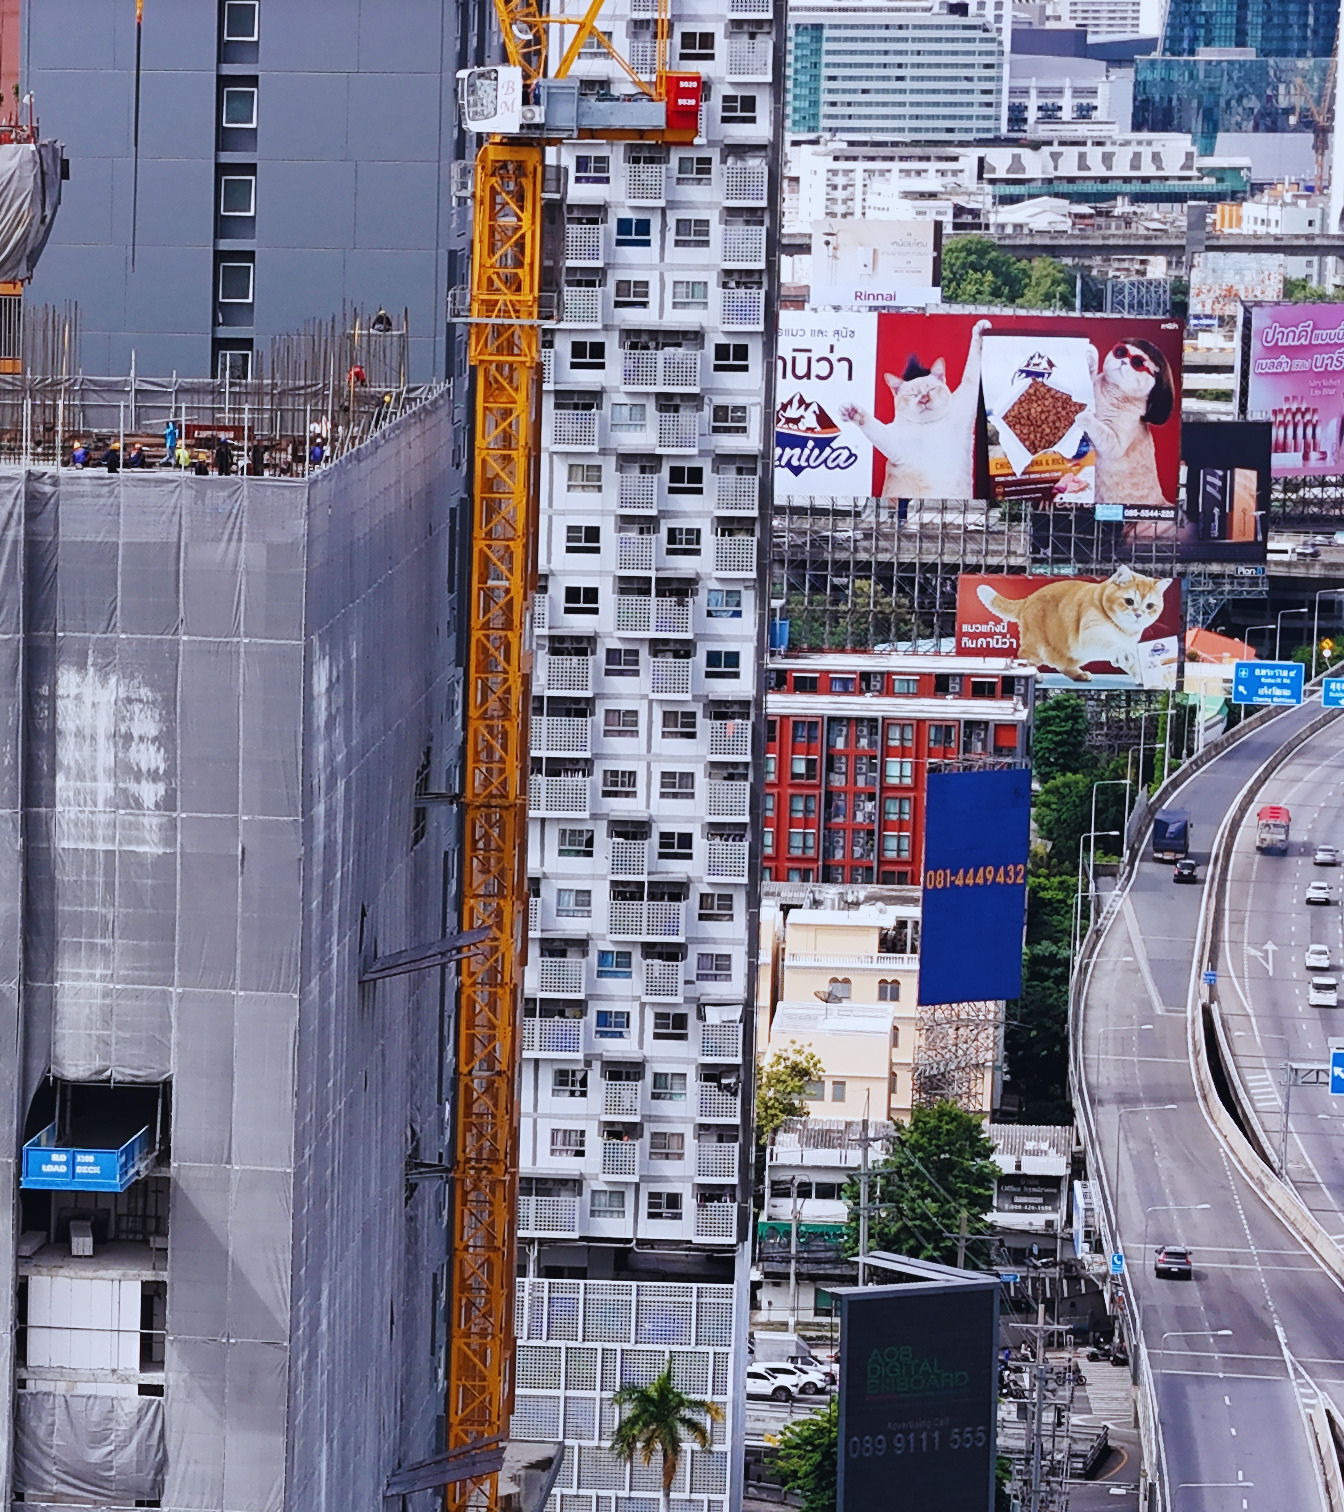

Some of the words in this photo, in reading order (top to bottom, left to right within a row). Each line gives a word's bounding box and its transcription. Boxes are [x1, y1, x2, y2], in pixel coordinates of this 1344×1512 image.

[854, 290, 897, 301] Rinnai
[926, 864, 1025, 889] 081-4449432
[41, 1164, 67, 1173] LOAD
[75, 1165, 100, 1174] DECK
[868, 1345, 913, 1362] AOB
[848, 1434, 887, 1458] 089
[893, 1430, 940, 1455] 9111
[949, 1425, 987, 1450] 555
